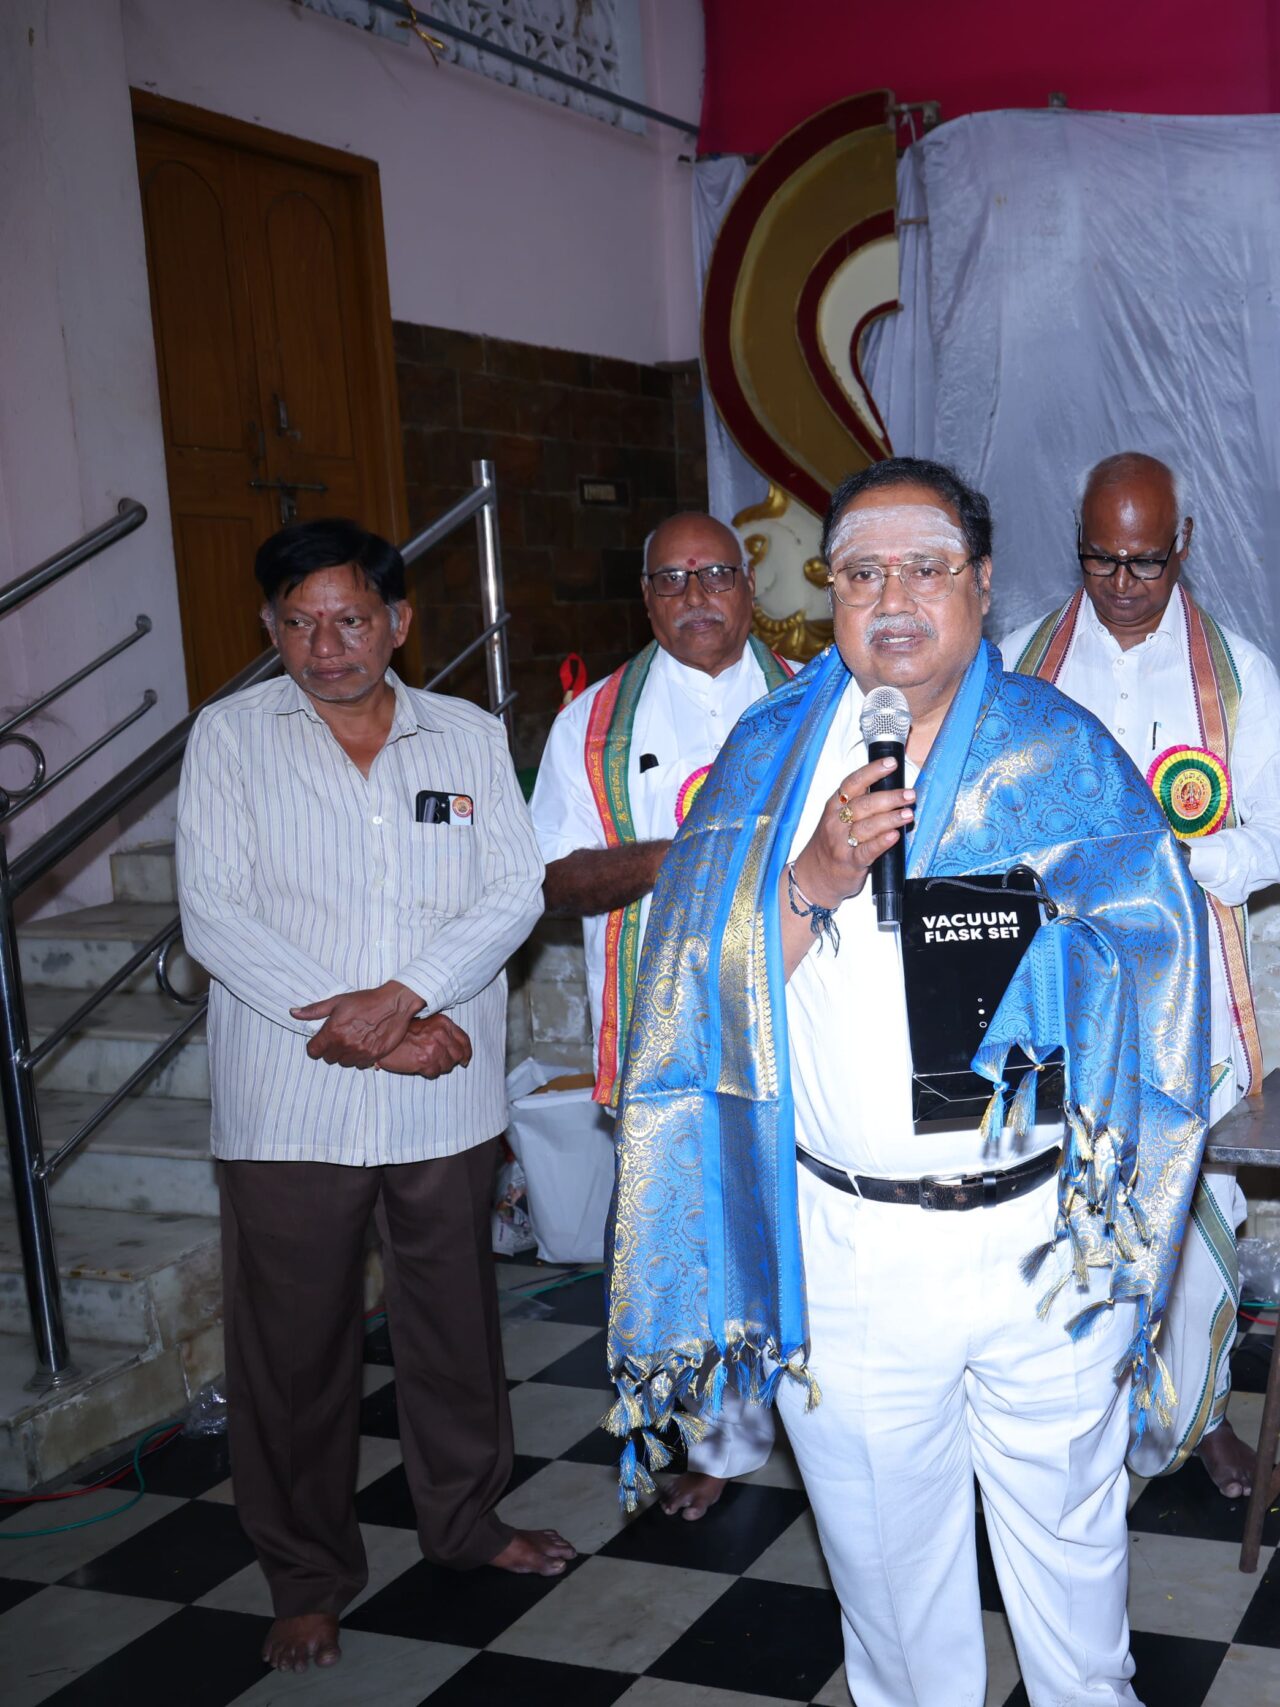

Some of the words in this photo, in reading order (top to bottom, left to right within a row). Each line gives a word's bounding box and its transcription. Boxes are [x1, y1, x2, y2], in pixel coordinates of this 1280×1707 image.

[922, 911, 1018, 929] VACUUM
[924, 927, 983, 943] FLASK
[988, 926, 1020, 939] SET
